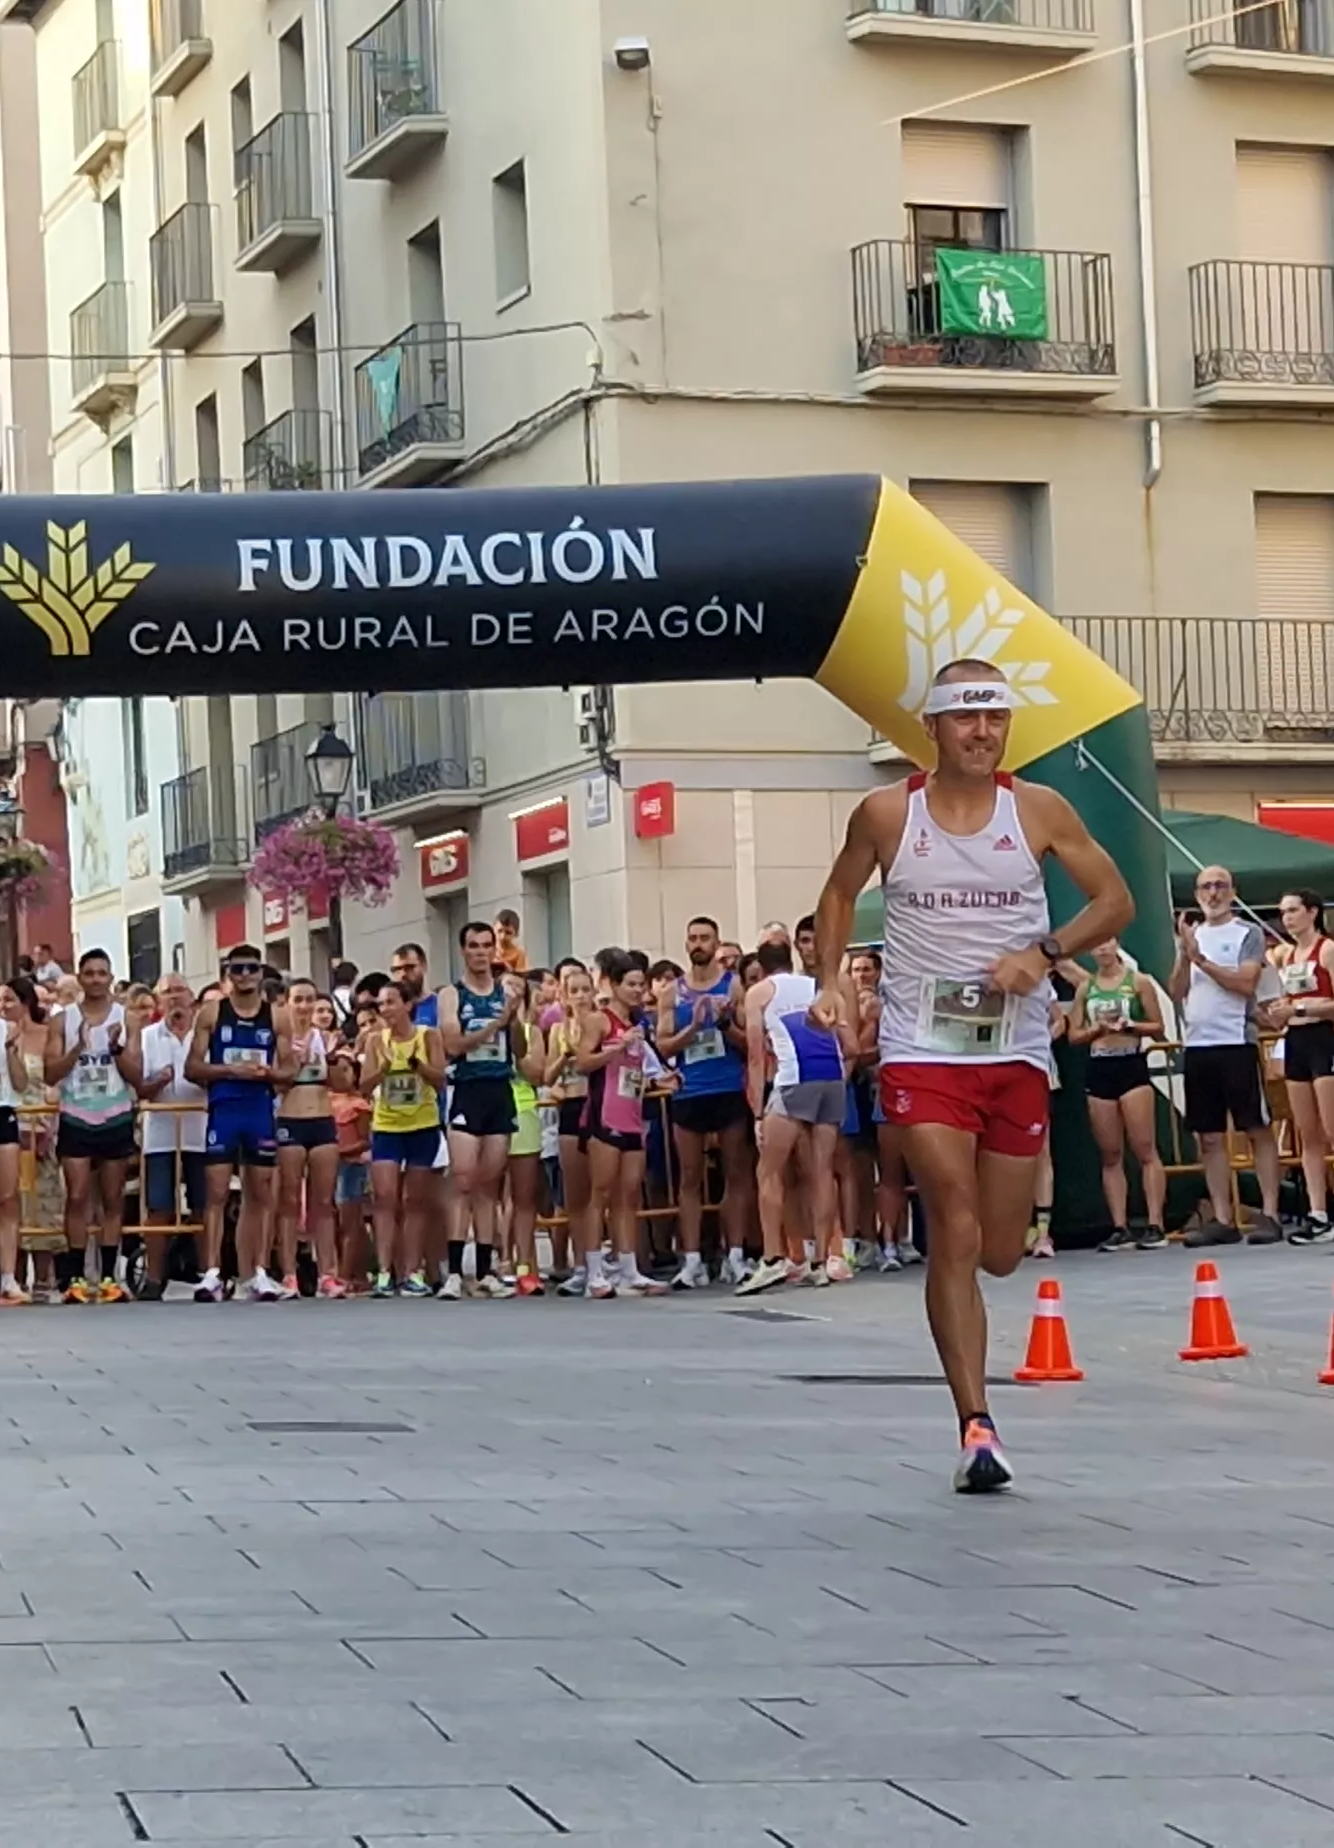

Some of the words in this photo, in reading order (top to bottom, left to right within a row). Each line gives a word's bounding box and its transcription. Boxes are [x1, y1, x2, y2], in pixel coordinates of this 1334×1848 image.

[236, 515, 659, 592] FUNDACIÓN
[128, 618, 262, 655] CAJA
[283, 614, 450, 652] RURAL
[471, 611, 534, 646] DE
[553, 595, 765, 639] ARAGÓN
[961, 984, 981, 1009] 5
